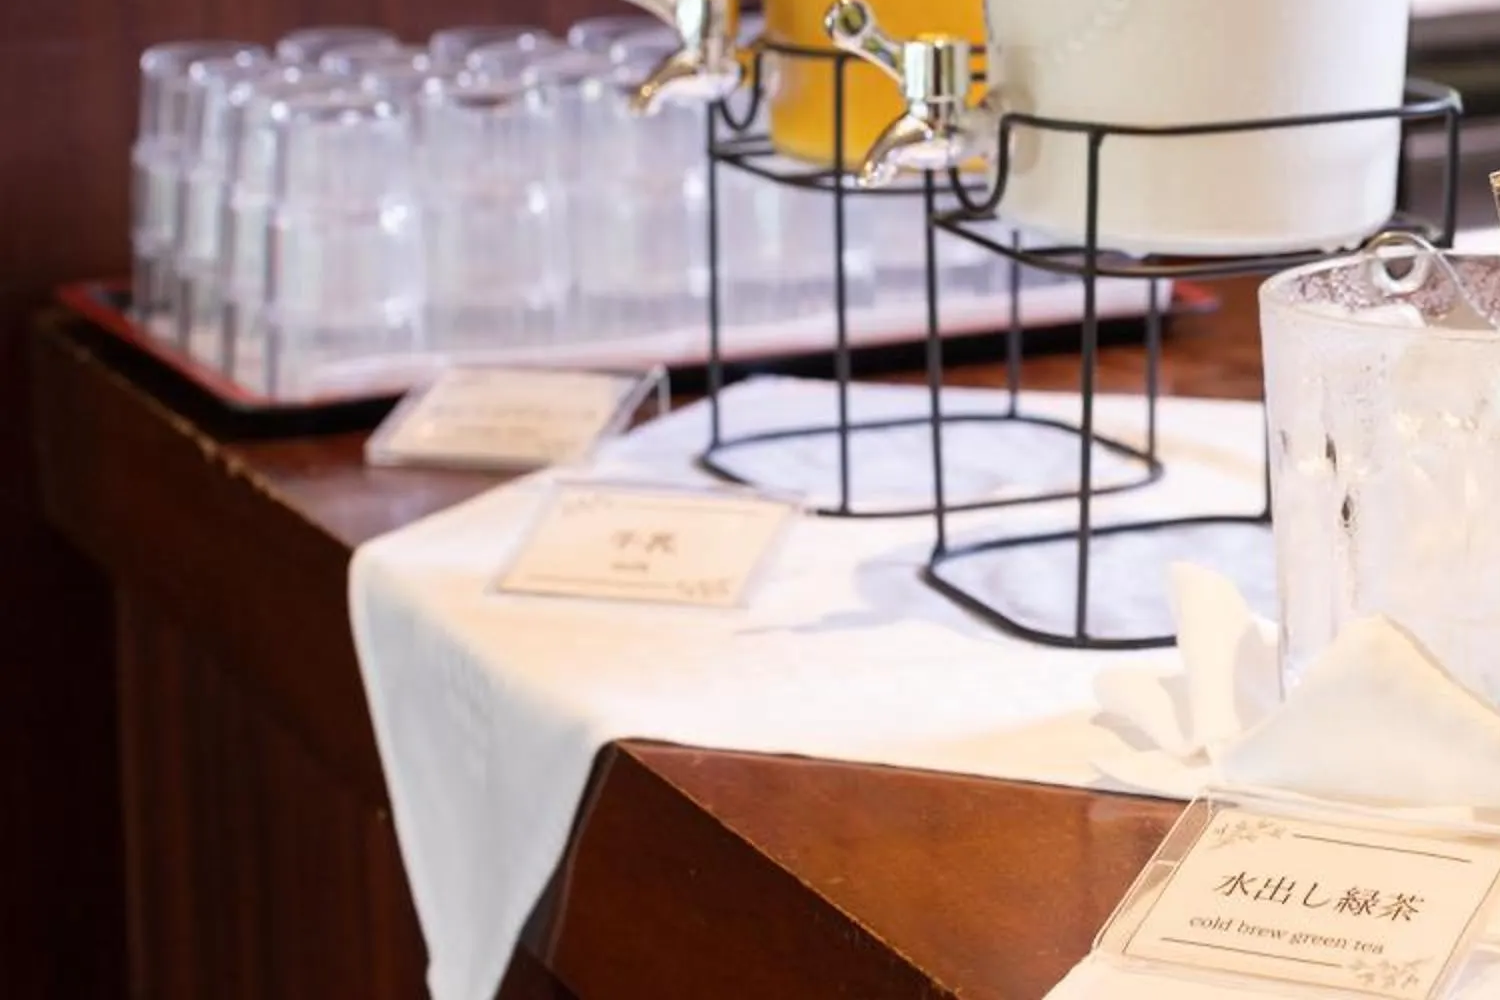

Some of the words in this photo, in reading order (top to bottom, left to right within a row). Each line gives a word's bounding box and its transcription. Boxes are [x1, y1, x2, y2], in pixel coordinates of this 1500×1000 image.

[1213, 871, 1425, 921] 水出し緑茶
[1189, 914, 1232, 934] cold
[1237, 920, 1288, 941] brew
[1289, 928, 1349, 950] green
[1354, 938, 1385, 955] tea
